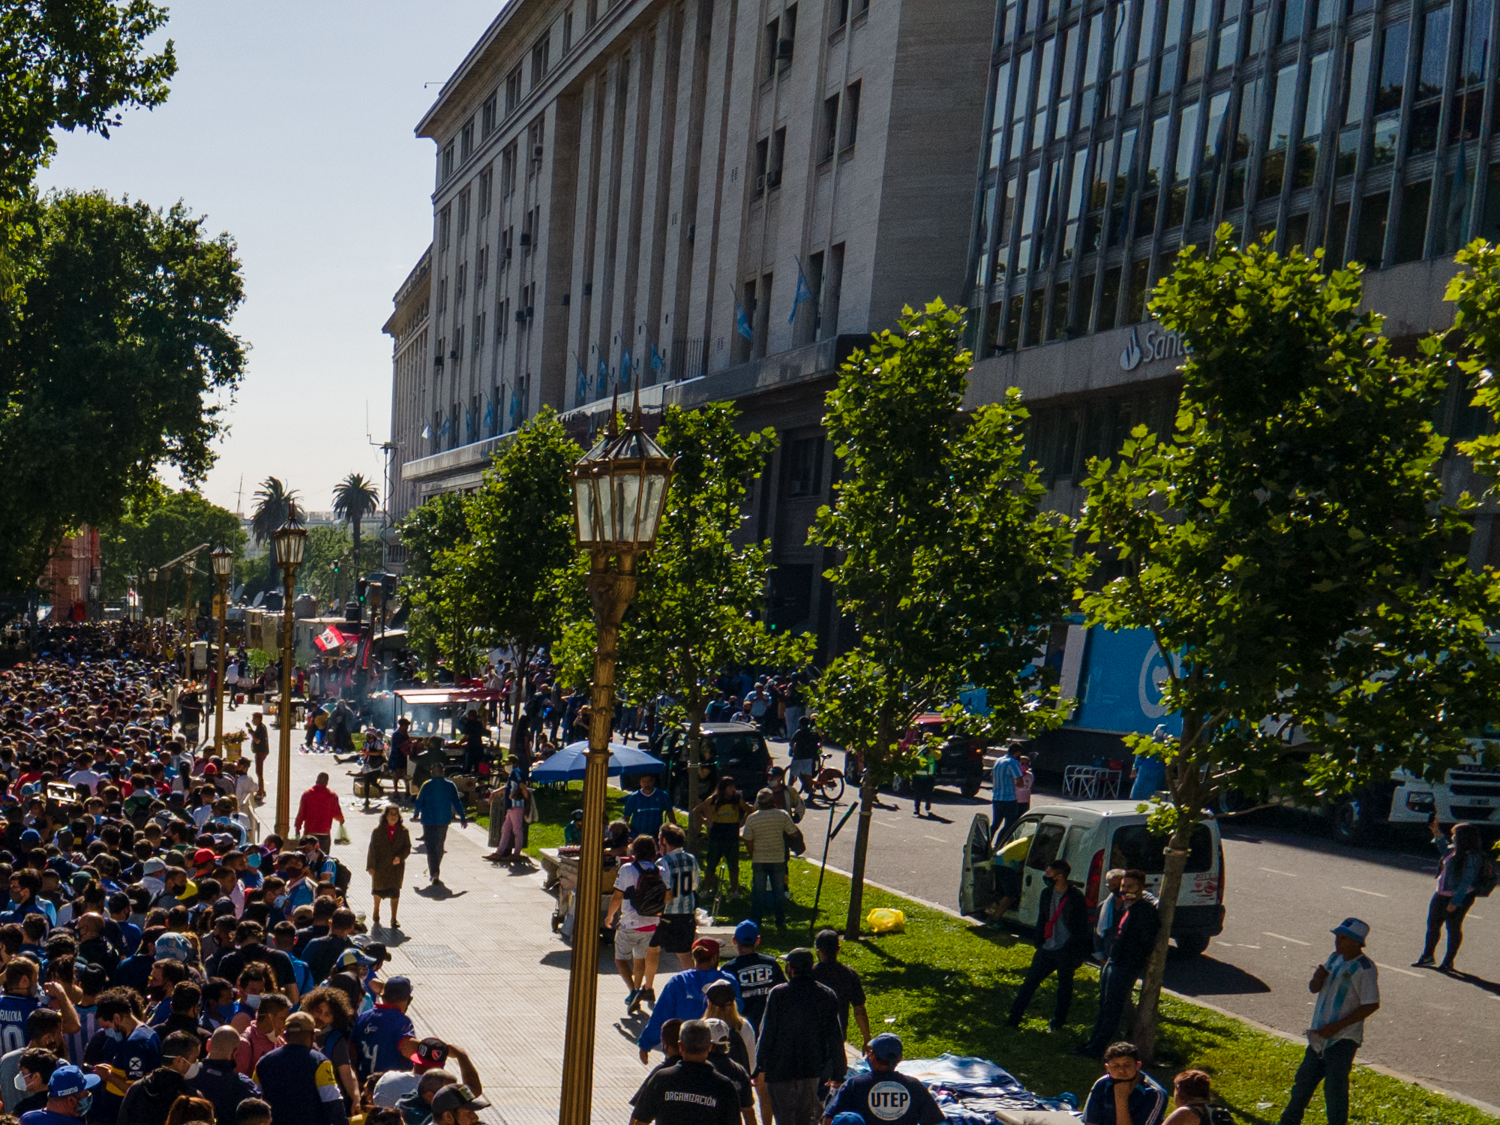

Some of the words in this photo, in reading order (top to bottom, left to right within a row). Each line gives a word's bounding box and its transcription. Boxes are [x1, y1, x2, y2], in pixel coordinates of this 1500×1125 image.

[672, 869, 693, 898] 10
[739, 968, 773, 984] CTEP
[664, 1091, 717, 1108] ORGANIZACIÓN
[871, 1092, 909, 1107] UTEP
